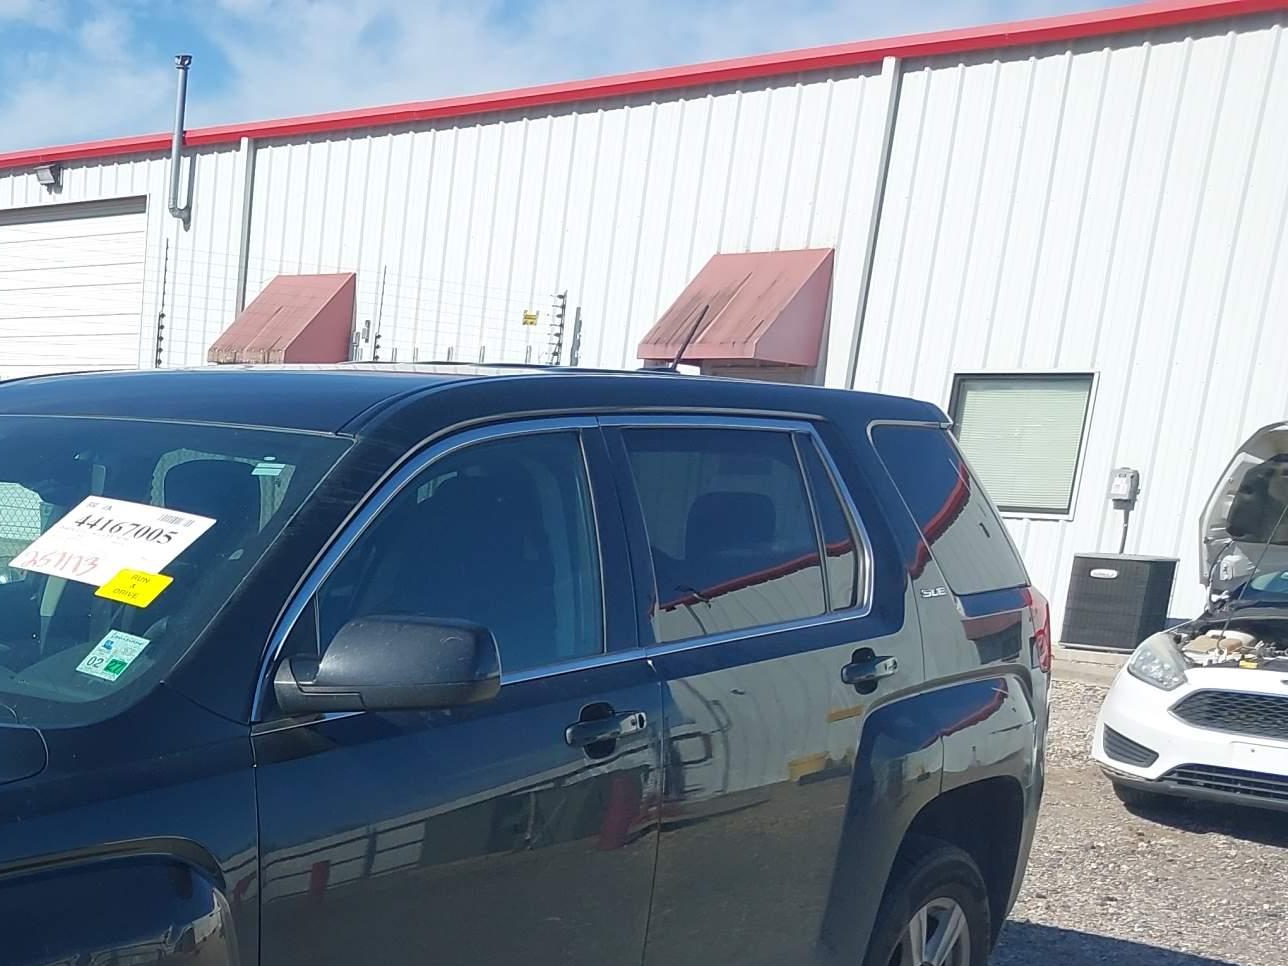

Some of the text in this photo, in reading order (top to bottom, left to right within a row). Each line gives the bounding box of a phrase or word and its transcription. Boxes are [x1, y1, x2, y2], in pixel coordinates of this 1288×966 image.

[75, 515, 179, 545] 44167005
[131, 574, 151, 584] RUN
[113, 588, 138, 599] DRIVE
[921, 587, 947, 598] SLE
[86, 656, 104, 669] 02
[107, 660, 125, 675] 27
